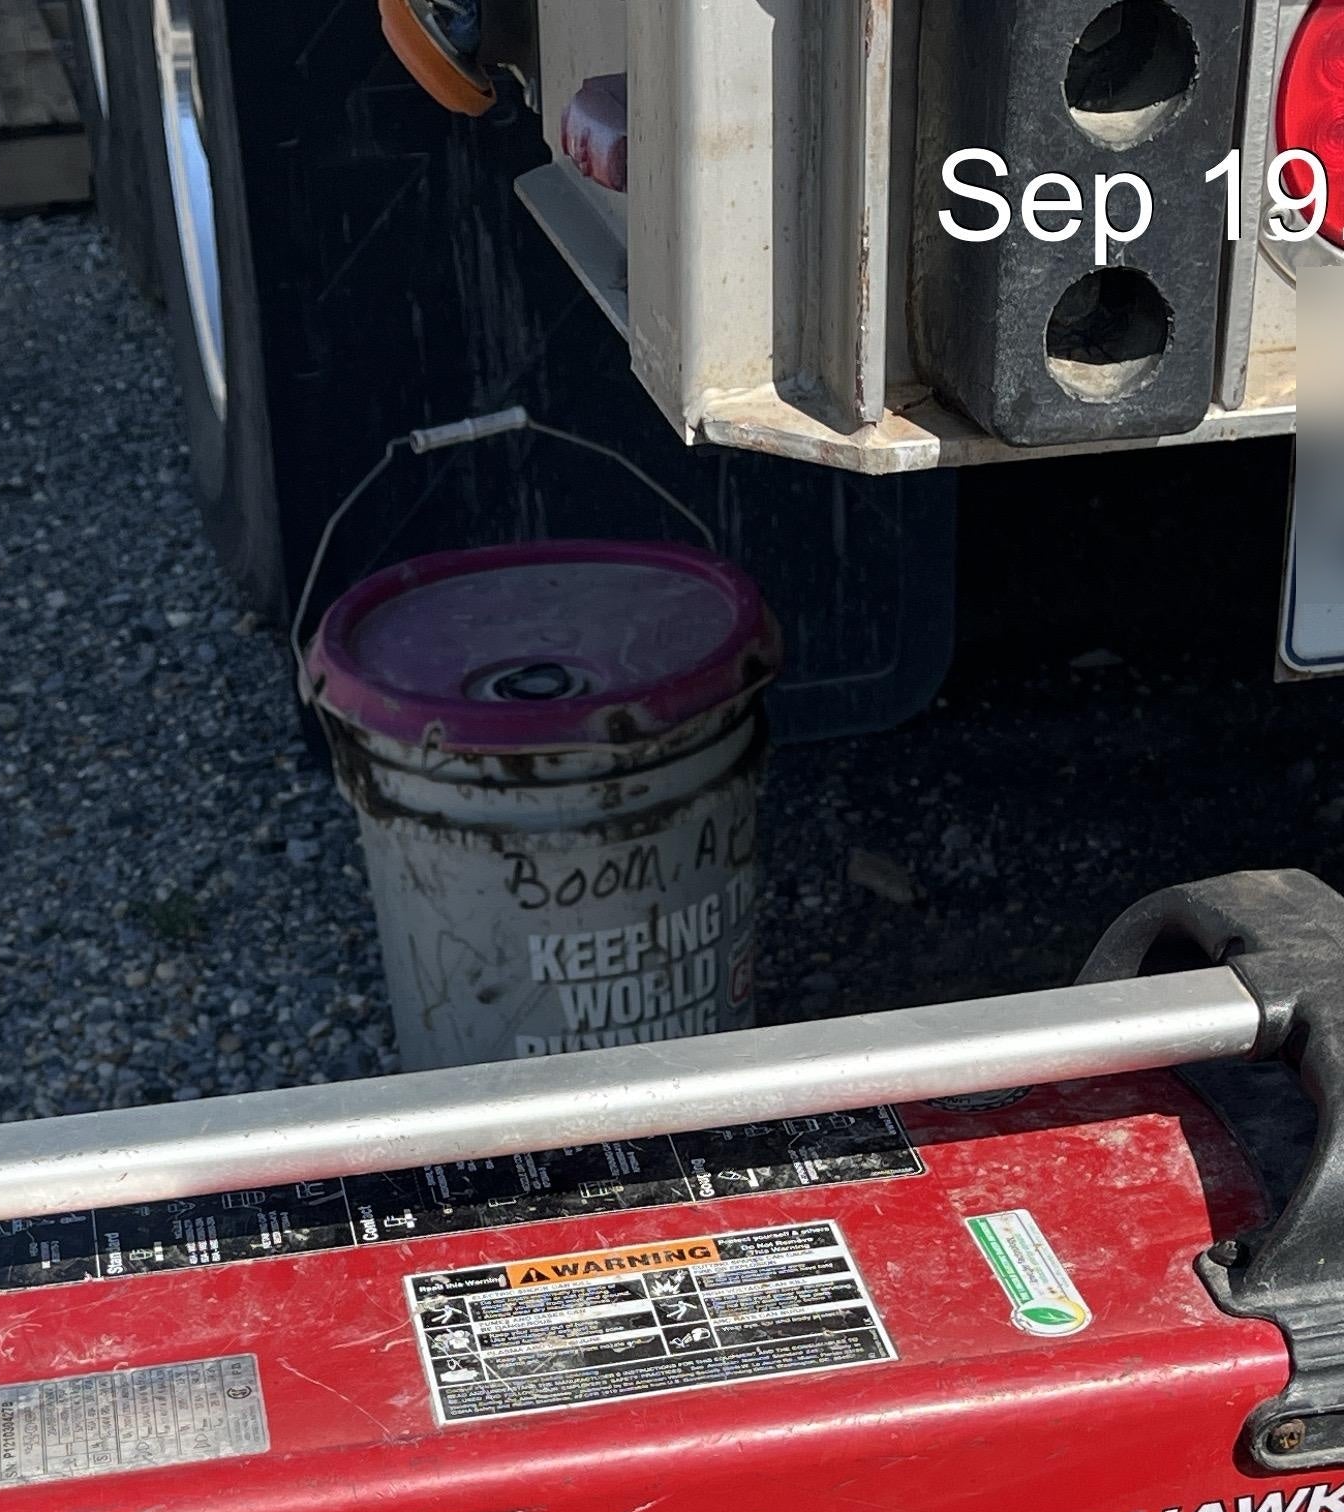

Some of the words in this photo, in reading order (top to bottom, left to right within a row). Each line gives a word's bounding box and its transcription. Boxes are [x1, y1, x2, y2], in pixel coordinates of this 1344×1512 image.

[558, 953, 718, 1032] WORLD
[104, 1231, 124, 1275] Standard
[550, 1245, 711, 1278] WARNING
